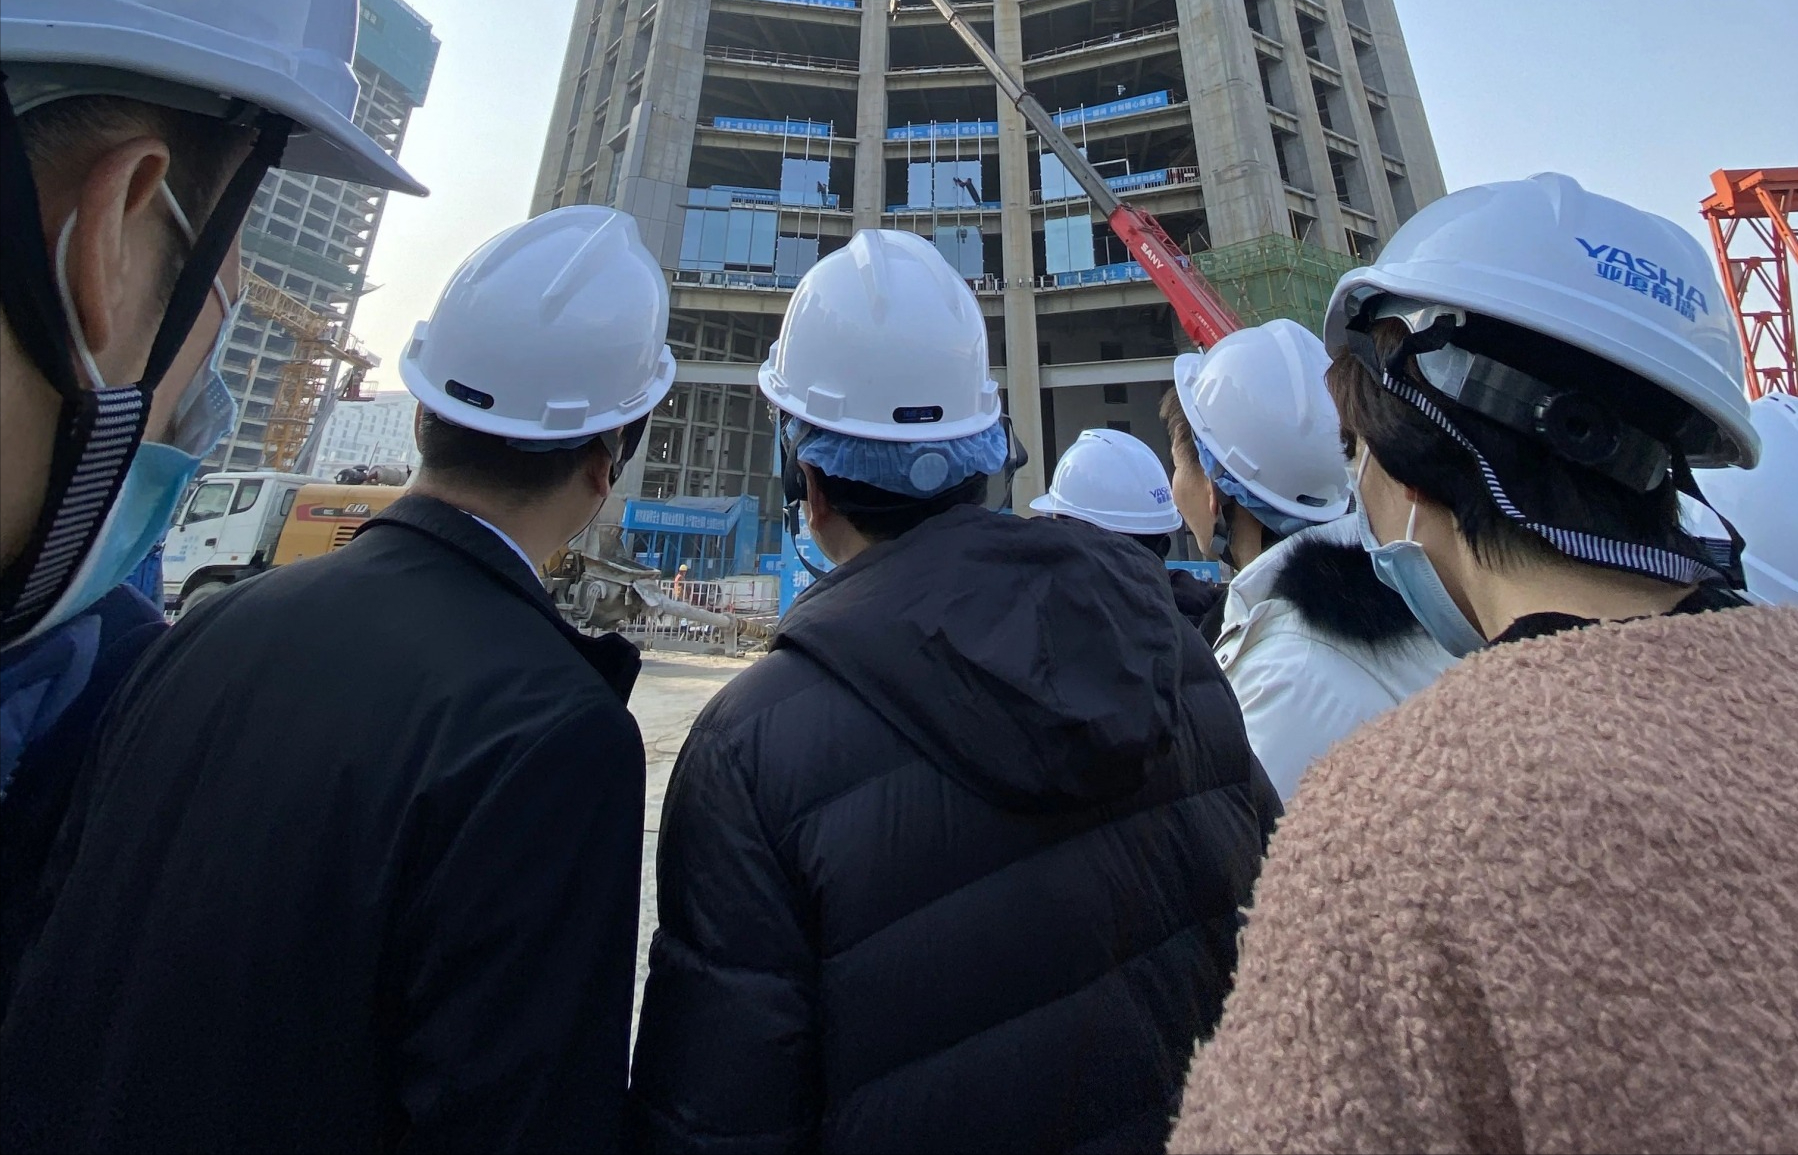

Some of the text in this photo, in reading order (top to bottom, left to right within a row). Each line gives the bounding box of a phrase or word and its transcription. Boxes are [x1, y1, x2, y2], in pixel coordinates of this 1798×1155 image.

[1140, 242, 1164, 270] SANY
[1574, 237, 1709, 316] YASHA
[1594, 260, 1697, 323] 亚厦幕墙
